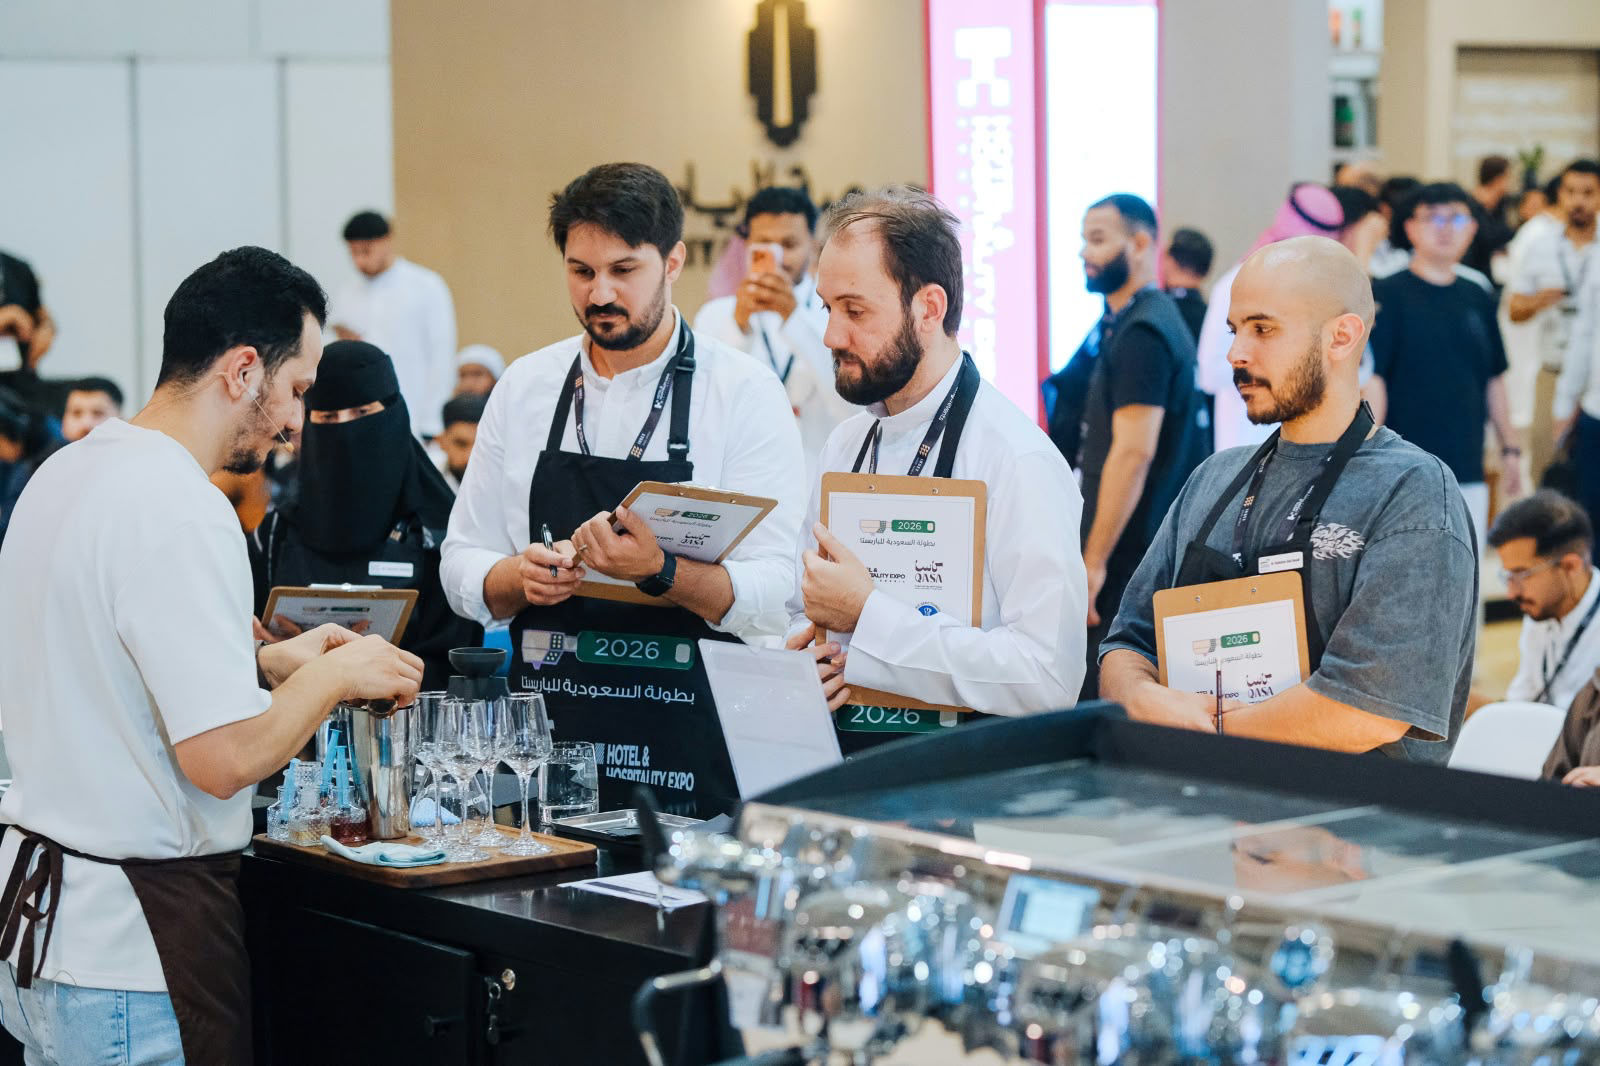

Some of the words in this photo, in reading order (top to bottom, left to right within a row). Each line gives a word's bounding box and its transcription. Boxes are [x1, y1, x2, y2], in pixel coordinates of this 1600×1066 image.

[897, 521, 922, 531] 2026
[914, 573, 943, 583] QASA
[594, 638, 660, 659] 2026
[1226, 635, 1248, 645] 2026
[521, 675, 561, 693] للباريستا
[562, 678, 641, 698] السعودية
[1248, 686, 1274, 698] QASA
[644, 685, 695, 705] بطولة
[850, 706, 920, 725] 2026
[606, 743, 641, 766] HOTEL
[642, 745, 650, 767] &
[667, 771, 695, 792] EXPO
